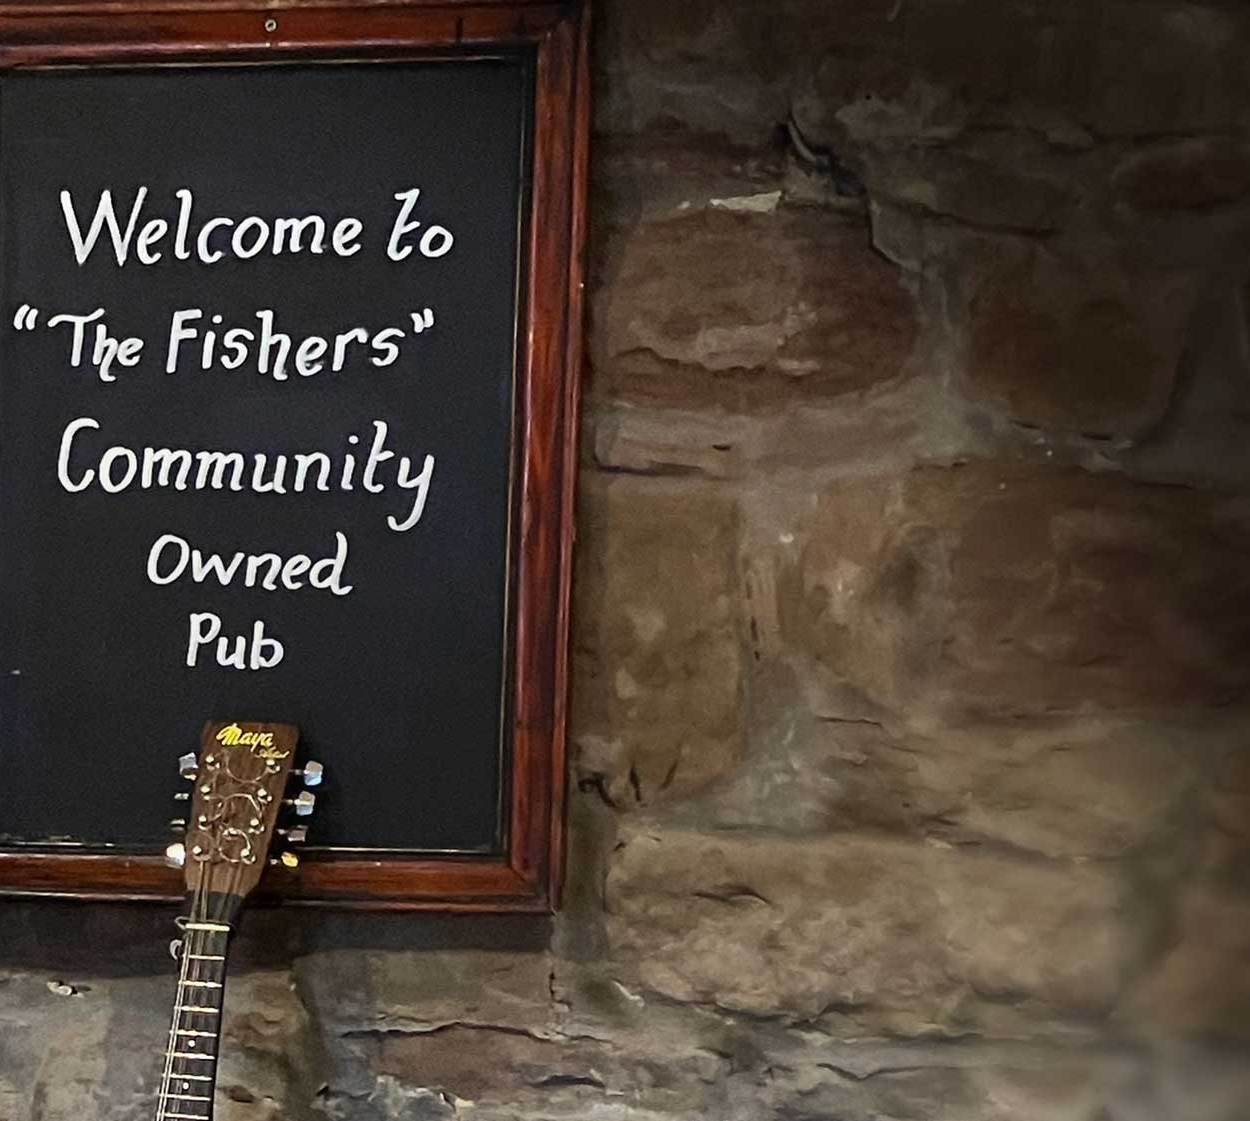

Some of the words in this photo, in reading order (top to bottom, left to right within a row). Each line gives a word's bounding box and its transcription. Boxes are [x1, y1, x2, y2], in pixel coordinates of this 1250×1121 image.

[59, 186, 363, 266] Welcome
[386, 188, 454, 261] to
[165, 307, 436, 381] Fishers"
[57, 418, 436, 531] Community
[147, 531, 353, 595] Owned
[186, 611, 284, 669] Pub
[216, 723, 273, 752] Maya
